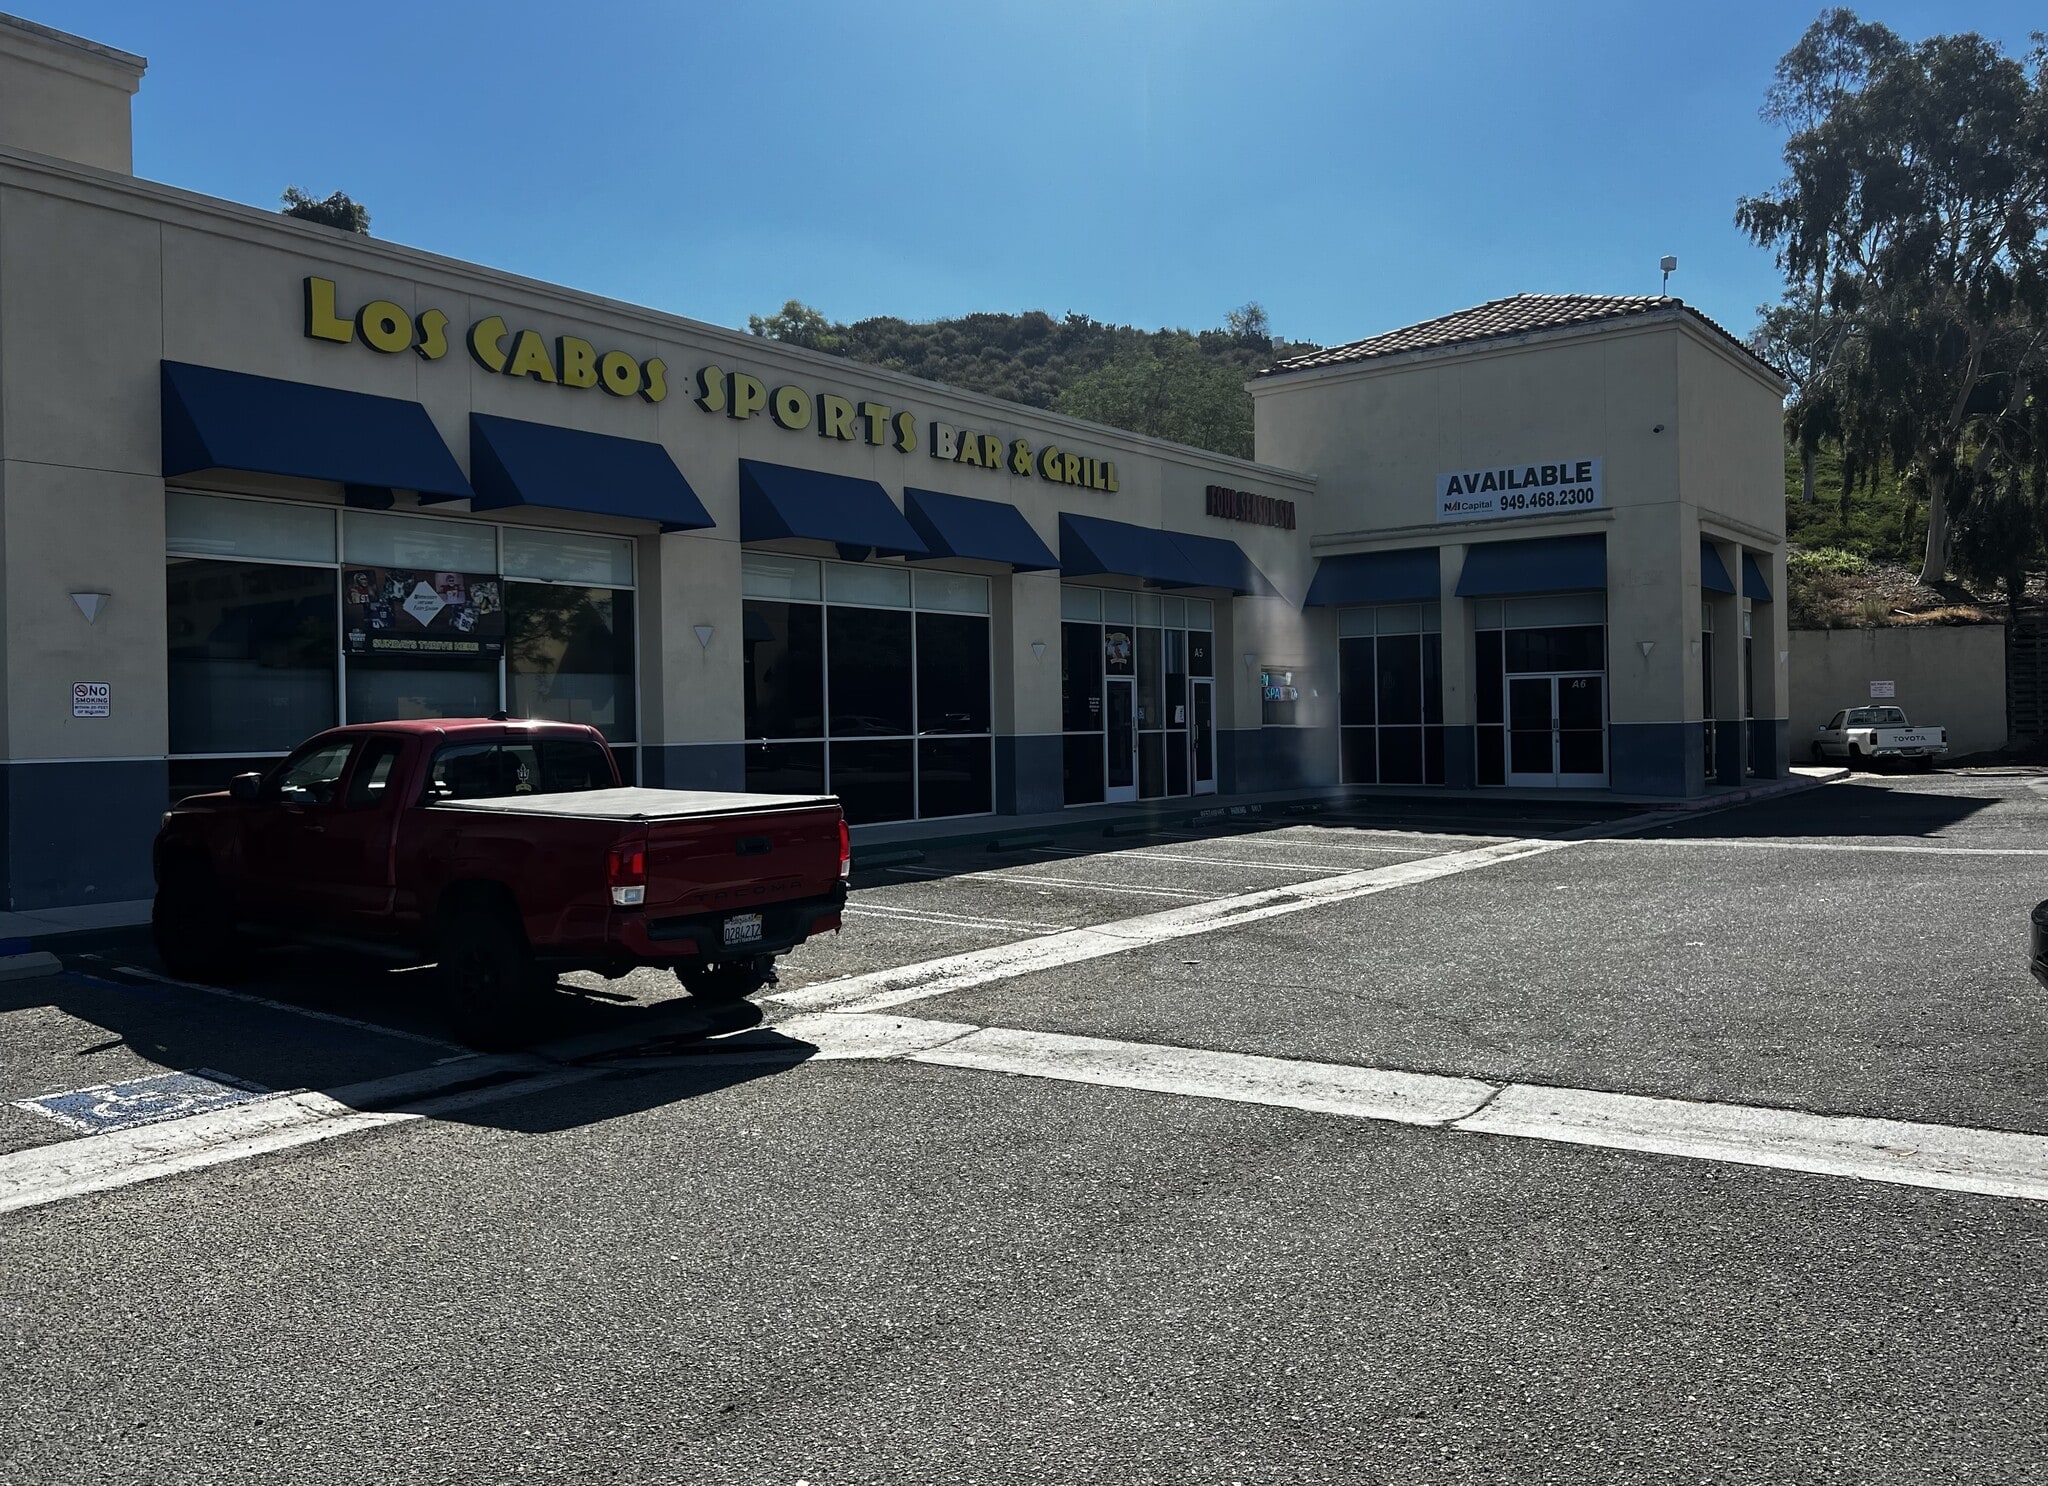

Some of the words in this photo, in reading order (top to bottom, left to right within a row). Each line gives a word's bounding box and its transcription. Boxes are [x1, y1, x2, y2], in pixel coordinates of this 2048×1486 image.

[303, 276, 449, 361] LOS
[466, 314, 668, 403] CABOS
[693, 364, 918, 454] SPORTS
[930, 421, 1003, 469] BAR
[1006, 438, 1035, 477] &
[1037, 444, 1120, 493] GRILL
[1446, 461, 1593, 496] AVAILABLE
[1500, 487, 1595, 511] 949.468.2300
[1461, 500, 1493, 511] Capital
[372, 639, 417, 650] SUNDAYS
[418, 640, 453, 651] THRIVE
[454, 641, 480, 652] HERE
[1194, 648, 1204, 657] A5
[1571, 679, 1587, 689] A6
[89, 685, 108, 696] NO
[1265, 687, 1280, 699] SPA
[693, 880, 803, 902] TACOMA
